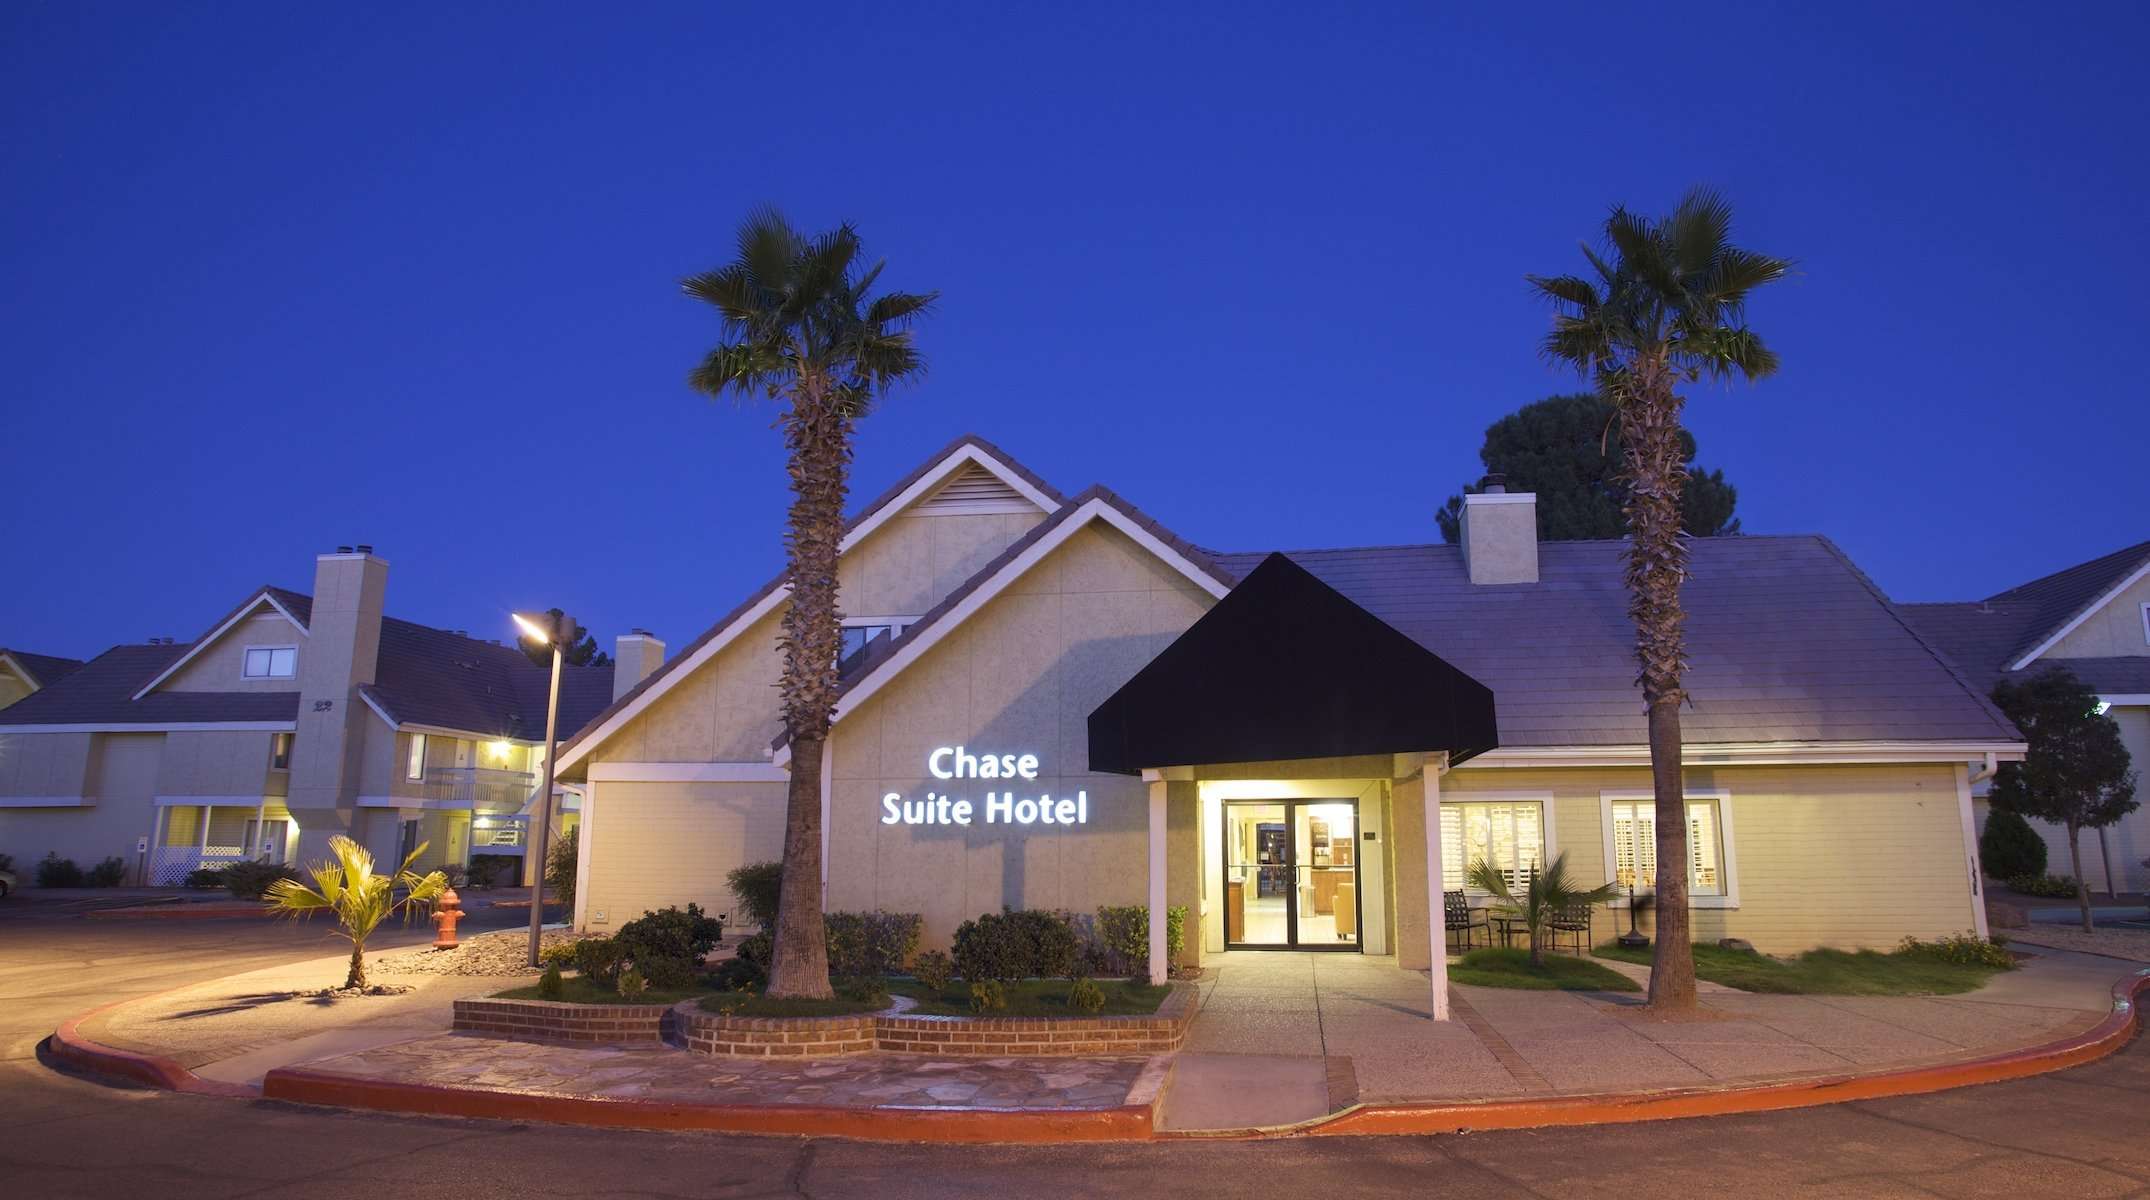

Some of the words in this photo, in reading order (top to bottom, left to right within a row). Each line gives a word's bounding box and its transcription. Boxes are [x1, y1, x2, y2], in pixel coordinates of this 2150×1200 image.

[928, 746, 1039, 779] Chase
[881, 792, 973, 825] Suite
[986, 790, 1087, 825] Hotel
